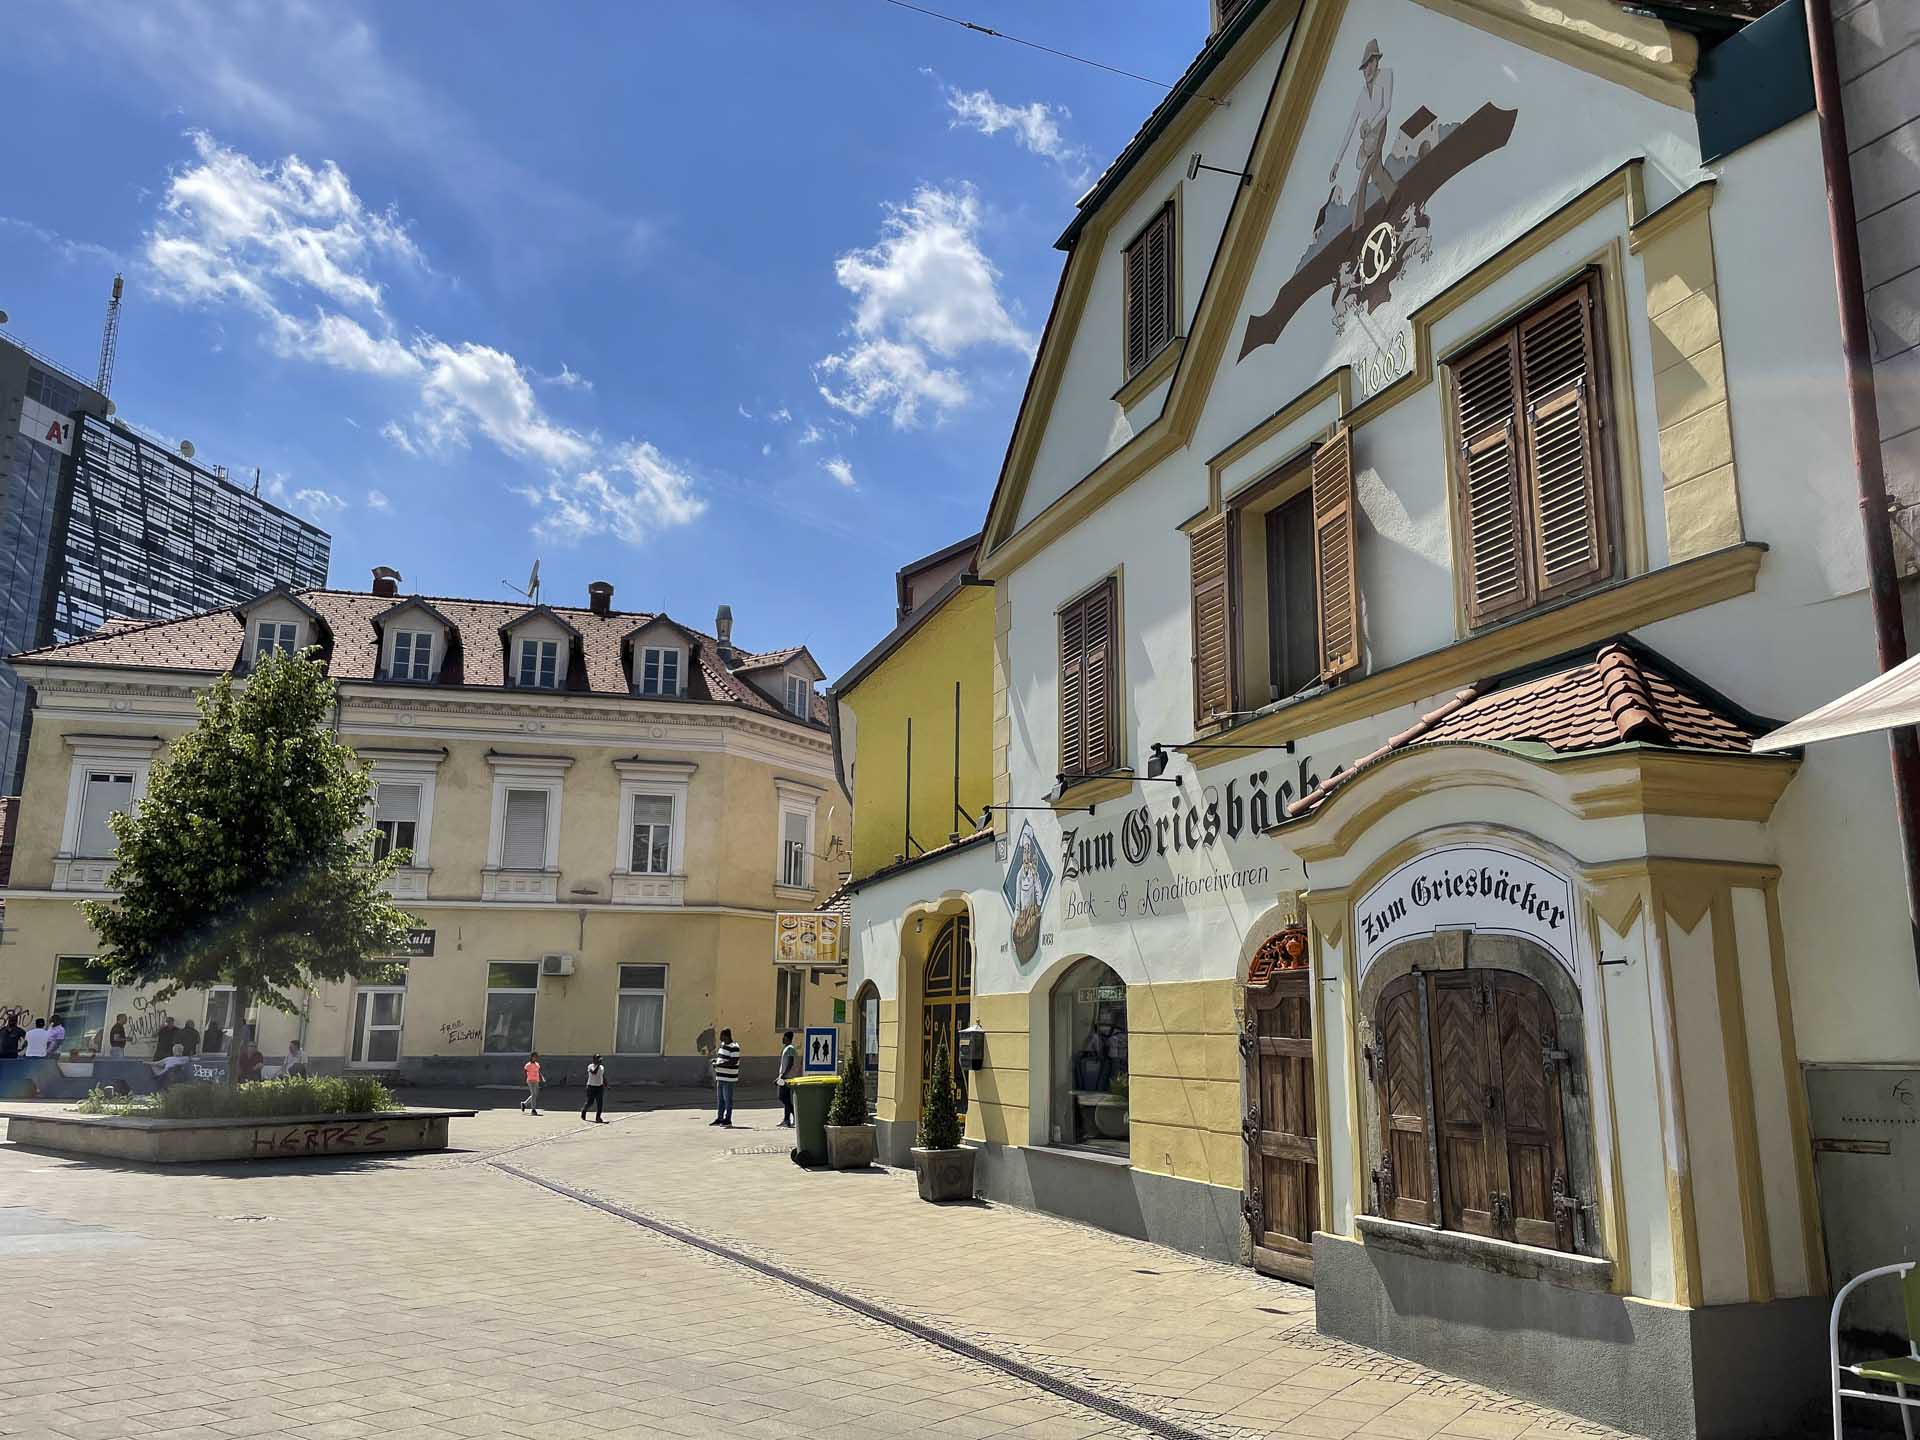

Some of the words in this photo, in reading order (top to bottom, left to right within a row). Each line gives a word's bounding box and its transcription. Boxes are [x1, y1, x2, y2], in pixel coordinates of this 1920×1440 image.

[1358, 330, 1407, 400] 1663
[46, 421, 70, 445] A1
[1061, 827, 1117, 887] Zum
[1137, 864, 1269, 917] Konditoreiwaren
[1361, 897, 1408, 947] Zum
[1410, 867, 1565, 930] Griesbäcker
[251, 1124, 389, 1152] HERPES
